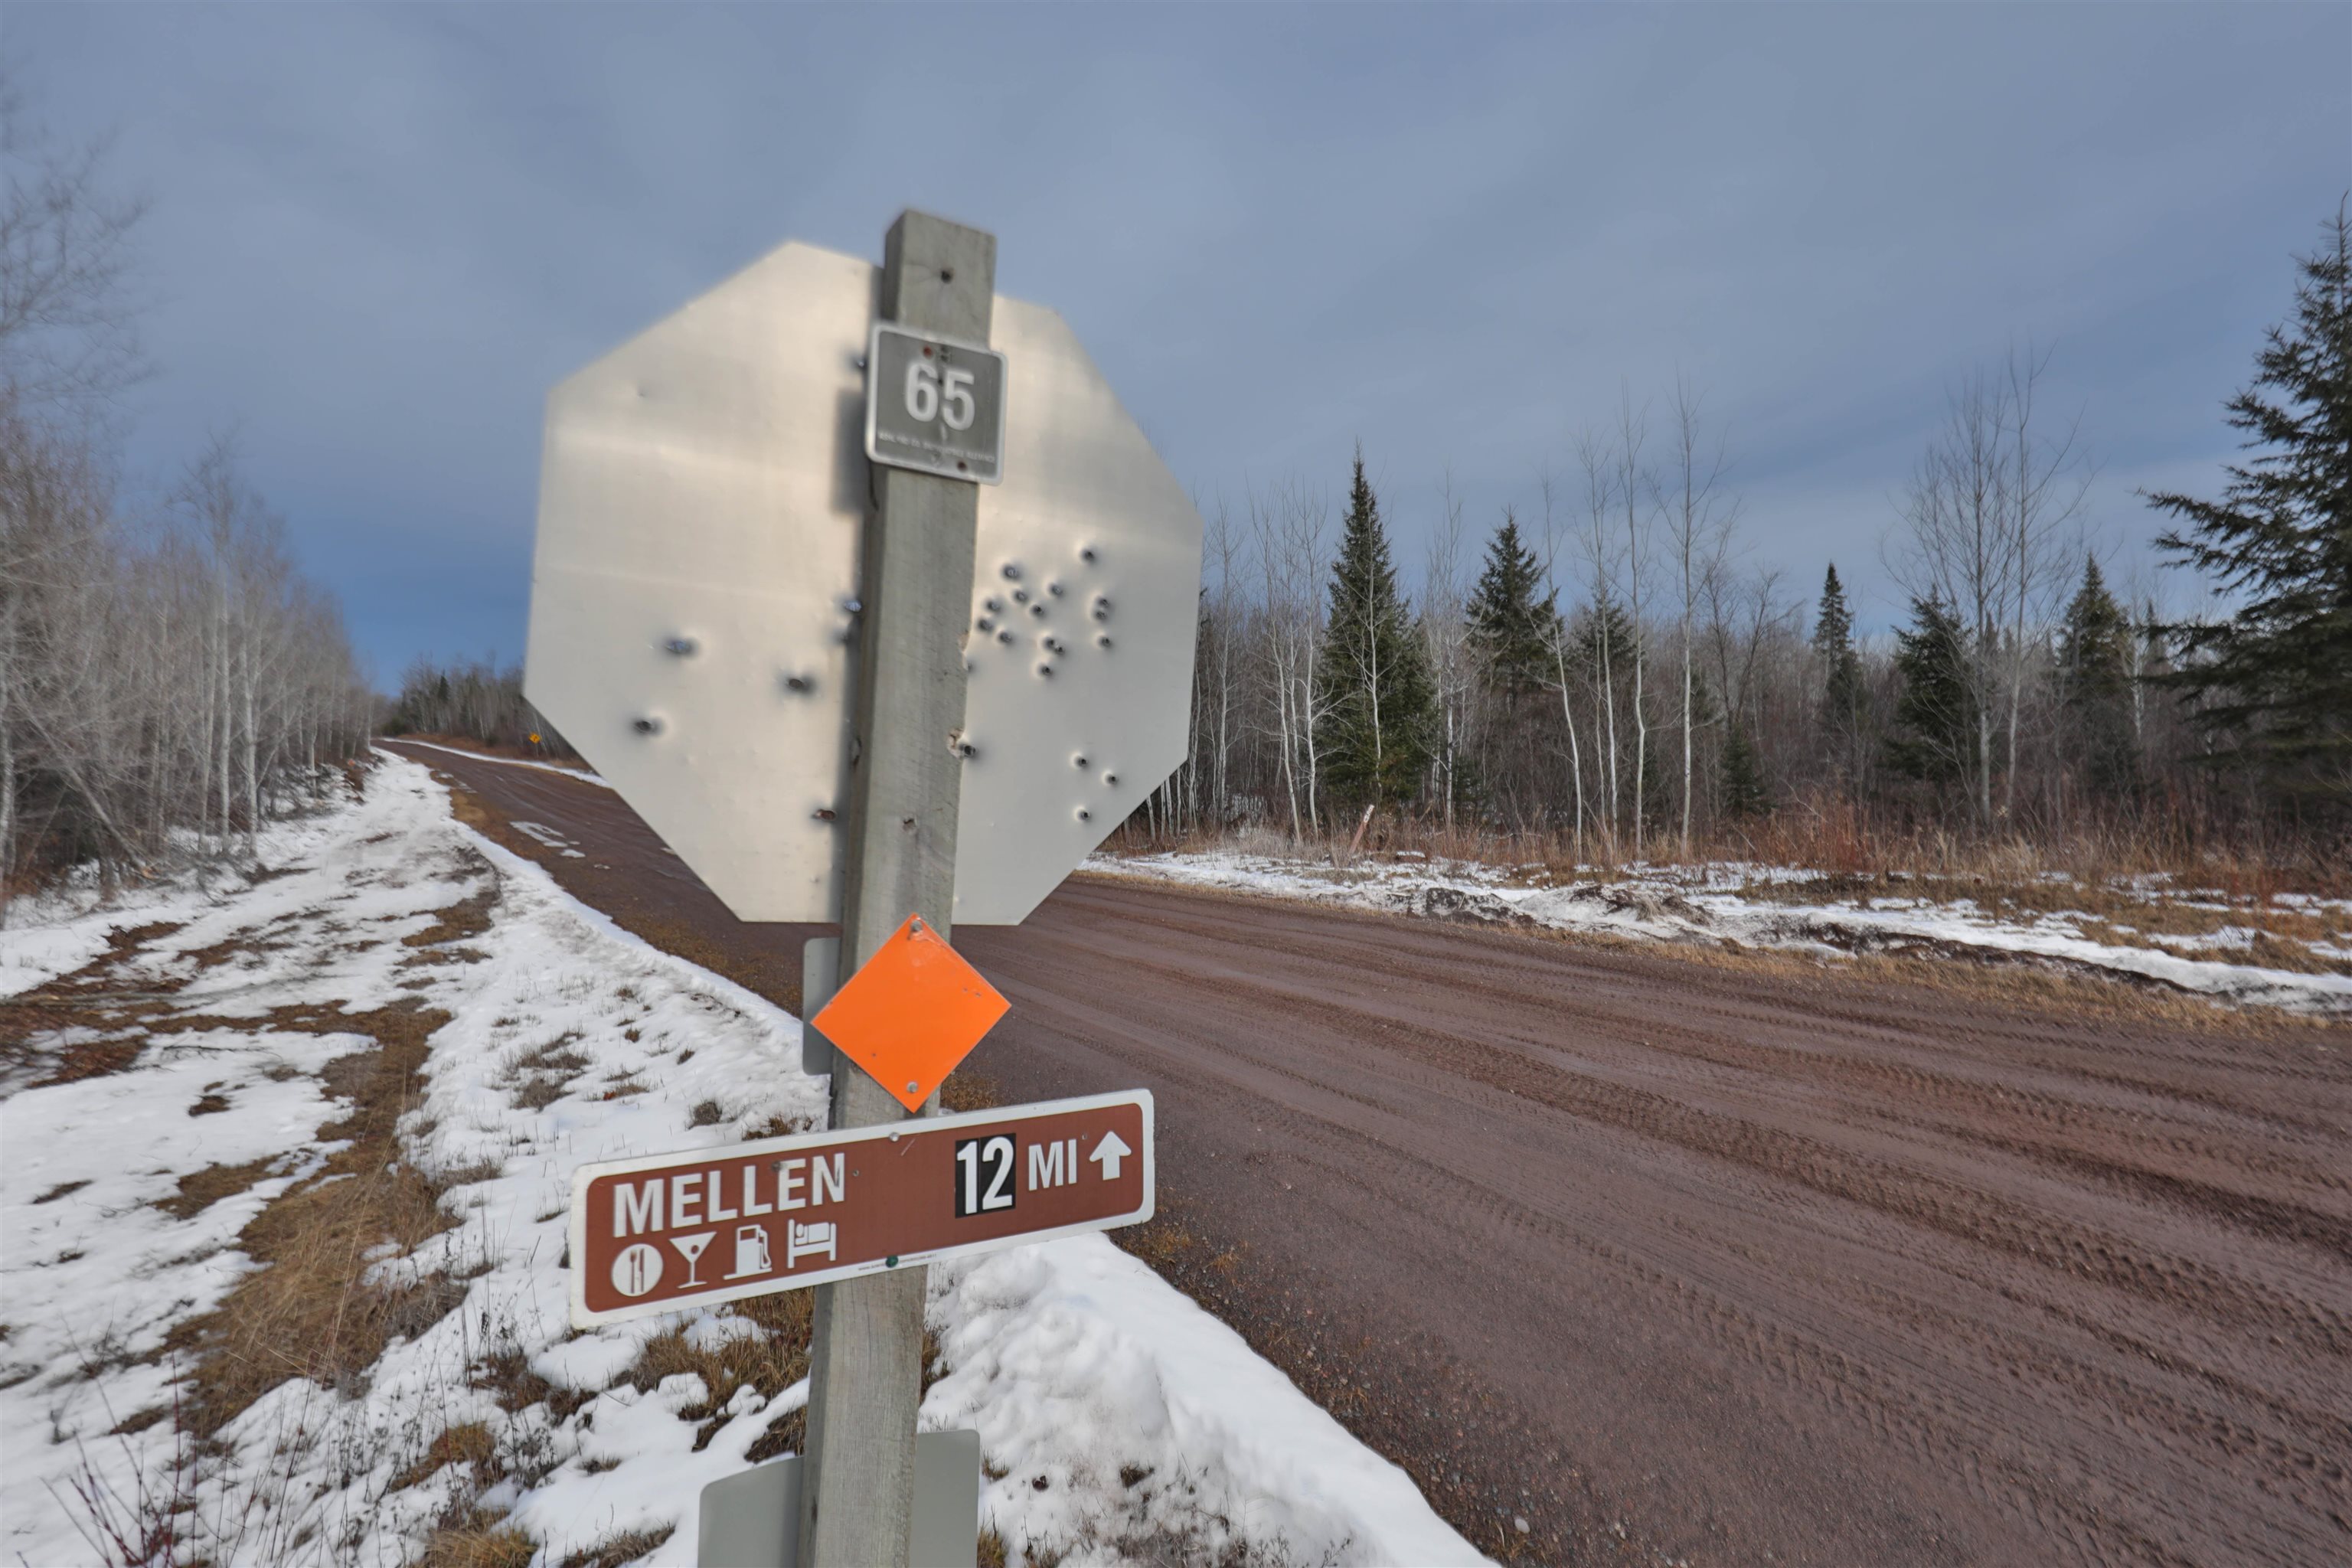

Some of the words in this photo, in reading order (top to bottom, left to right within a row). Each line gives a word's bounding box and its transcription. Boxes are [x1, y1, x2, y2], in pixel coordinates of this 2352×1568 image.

[906, 363, 975, 431] 65
[613, 1152, 844, 1238] MELLEN
[957, 1136, 1014, 1214] 12
[1028, 1138, 1077, 1191] MI
